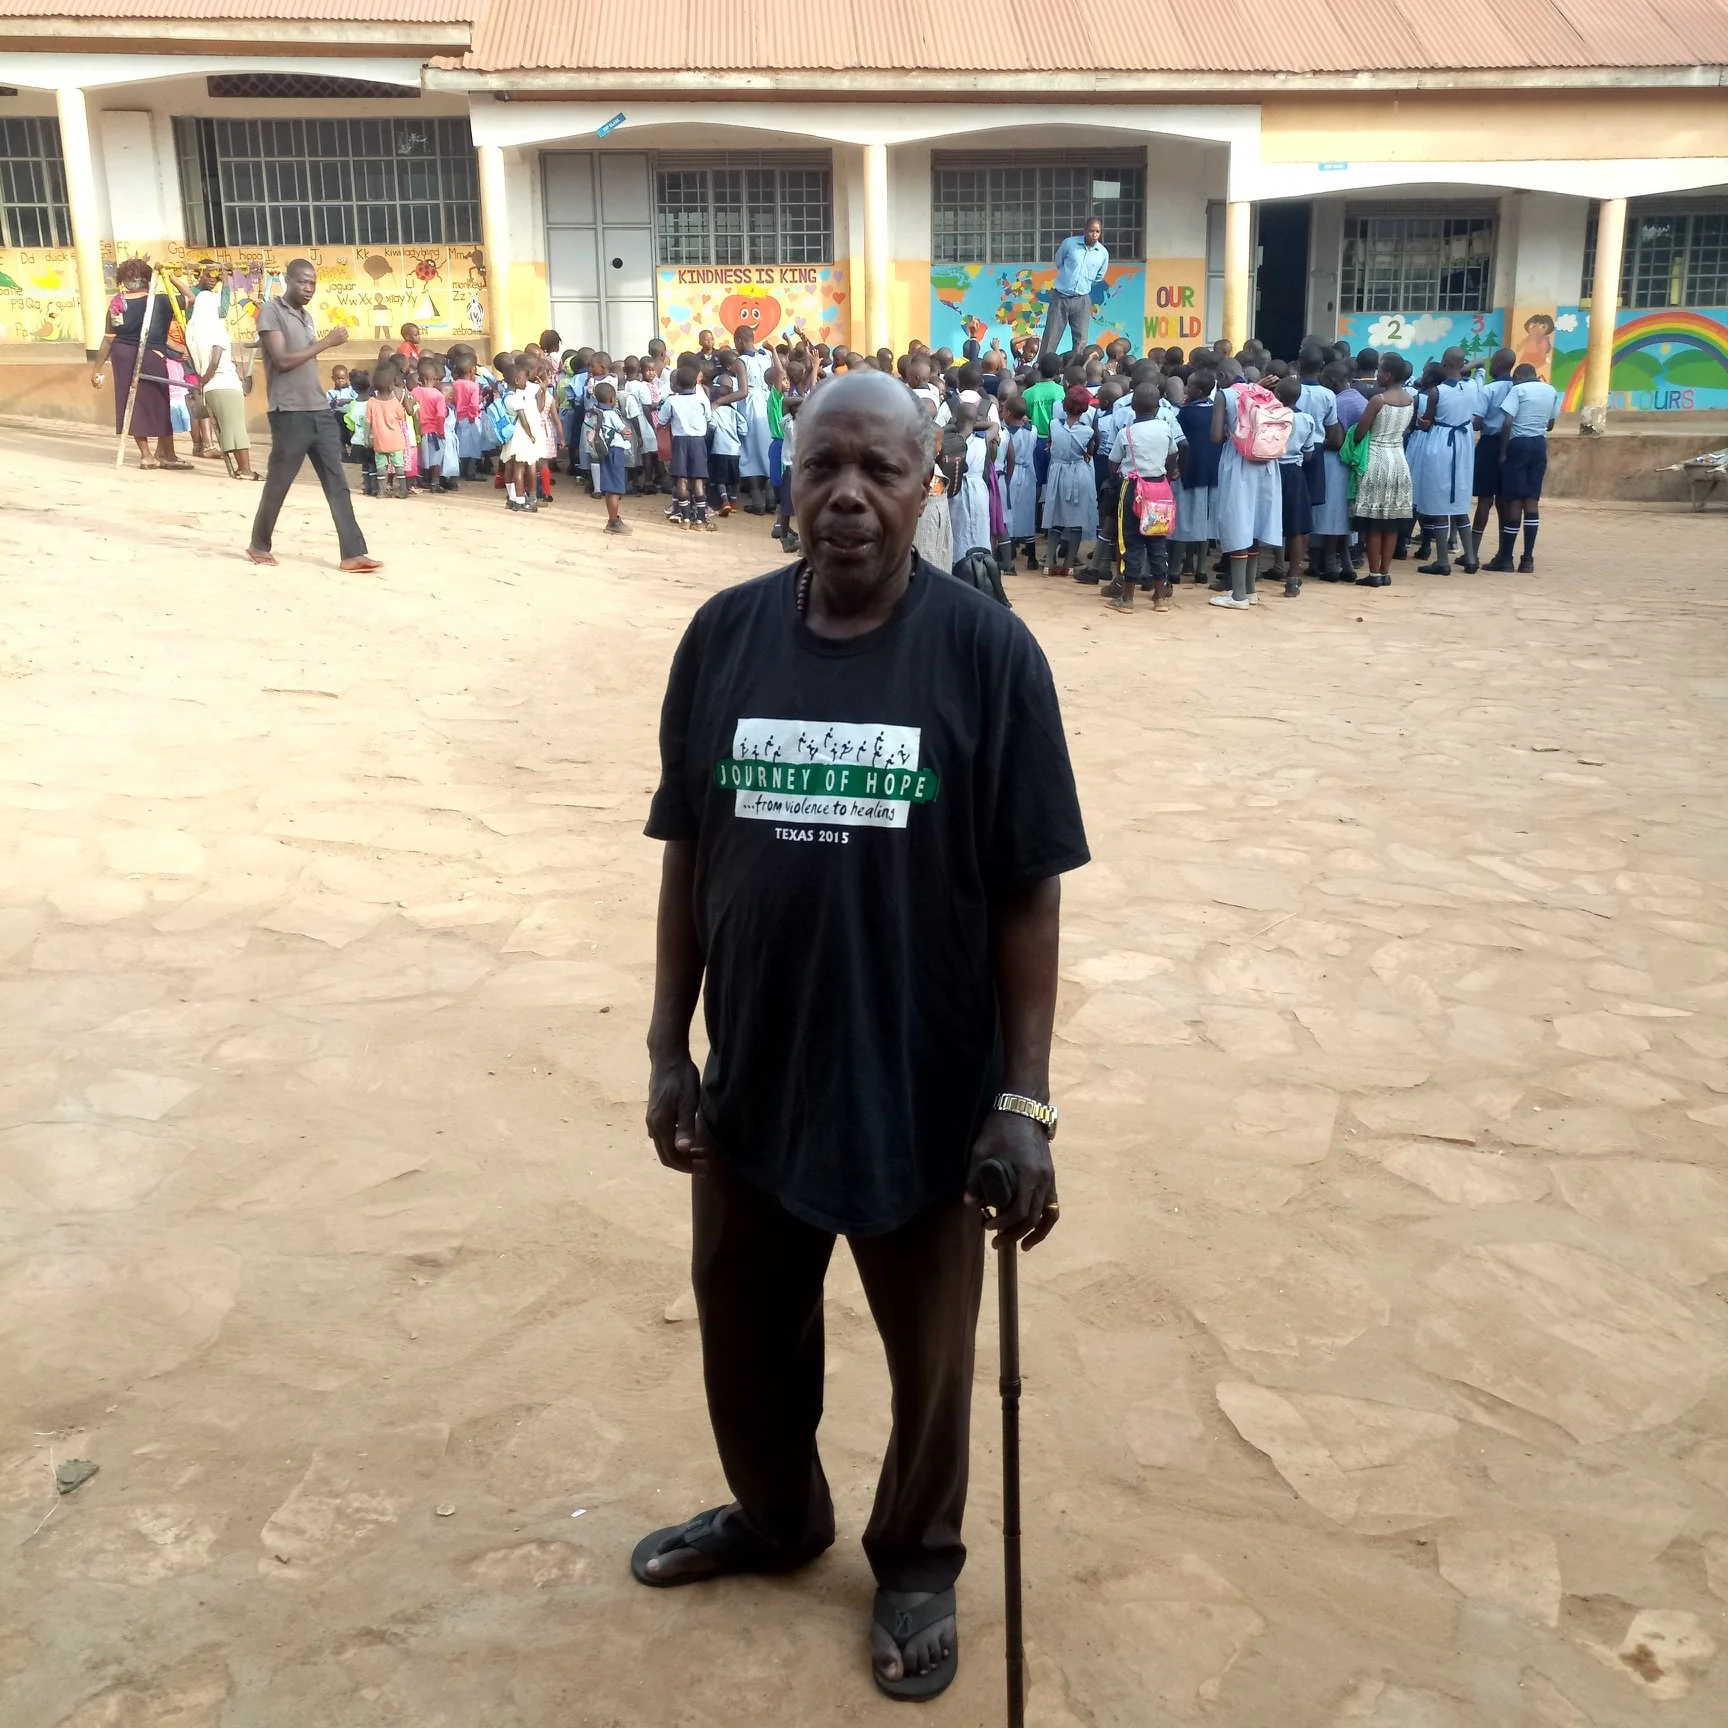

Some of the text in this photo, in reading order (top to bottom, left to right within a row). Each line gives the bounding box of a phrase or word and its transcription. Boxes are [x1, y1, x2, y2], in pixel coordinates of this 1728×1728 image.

[20, 252, 35, 265] Dd
[403, 248, 440, 259] ladybird
[677, 268, 818, 285] KINDNESS IS KING
[326, 283, 356, 295] jaguar
[452, 278, 483, 291] monkey
[337, 294, 358, 306] Ww
[358, 293, 373, 306] Xx
[452, 290, 466, 301] Zz
[1156, 285, 1195, 308] OUR
[452, 323, 473, 336] zebra
[1143, 316, 1202, 339] WORLD
[1387, 320, 1402, 340] 2
[1470, 315, 1485, 334] 3
[720, 764, 926, 798] JOURNEY OF HOPE
[785, 796, 830, 815] violence
[833, 799, 848, 816] to
[849, 800, 896, 821] healing
[774, 827, 850, 844] TEXAS 2015
